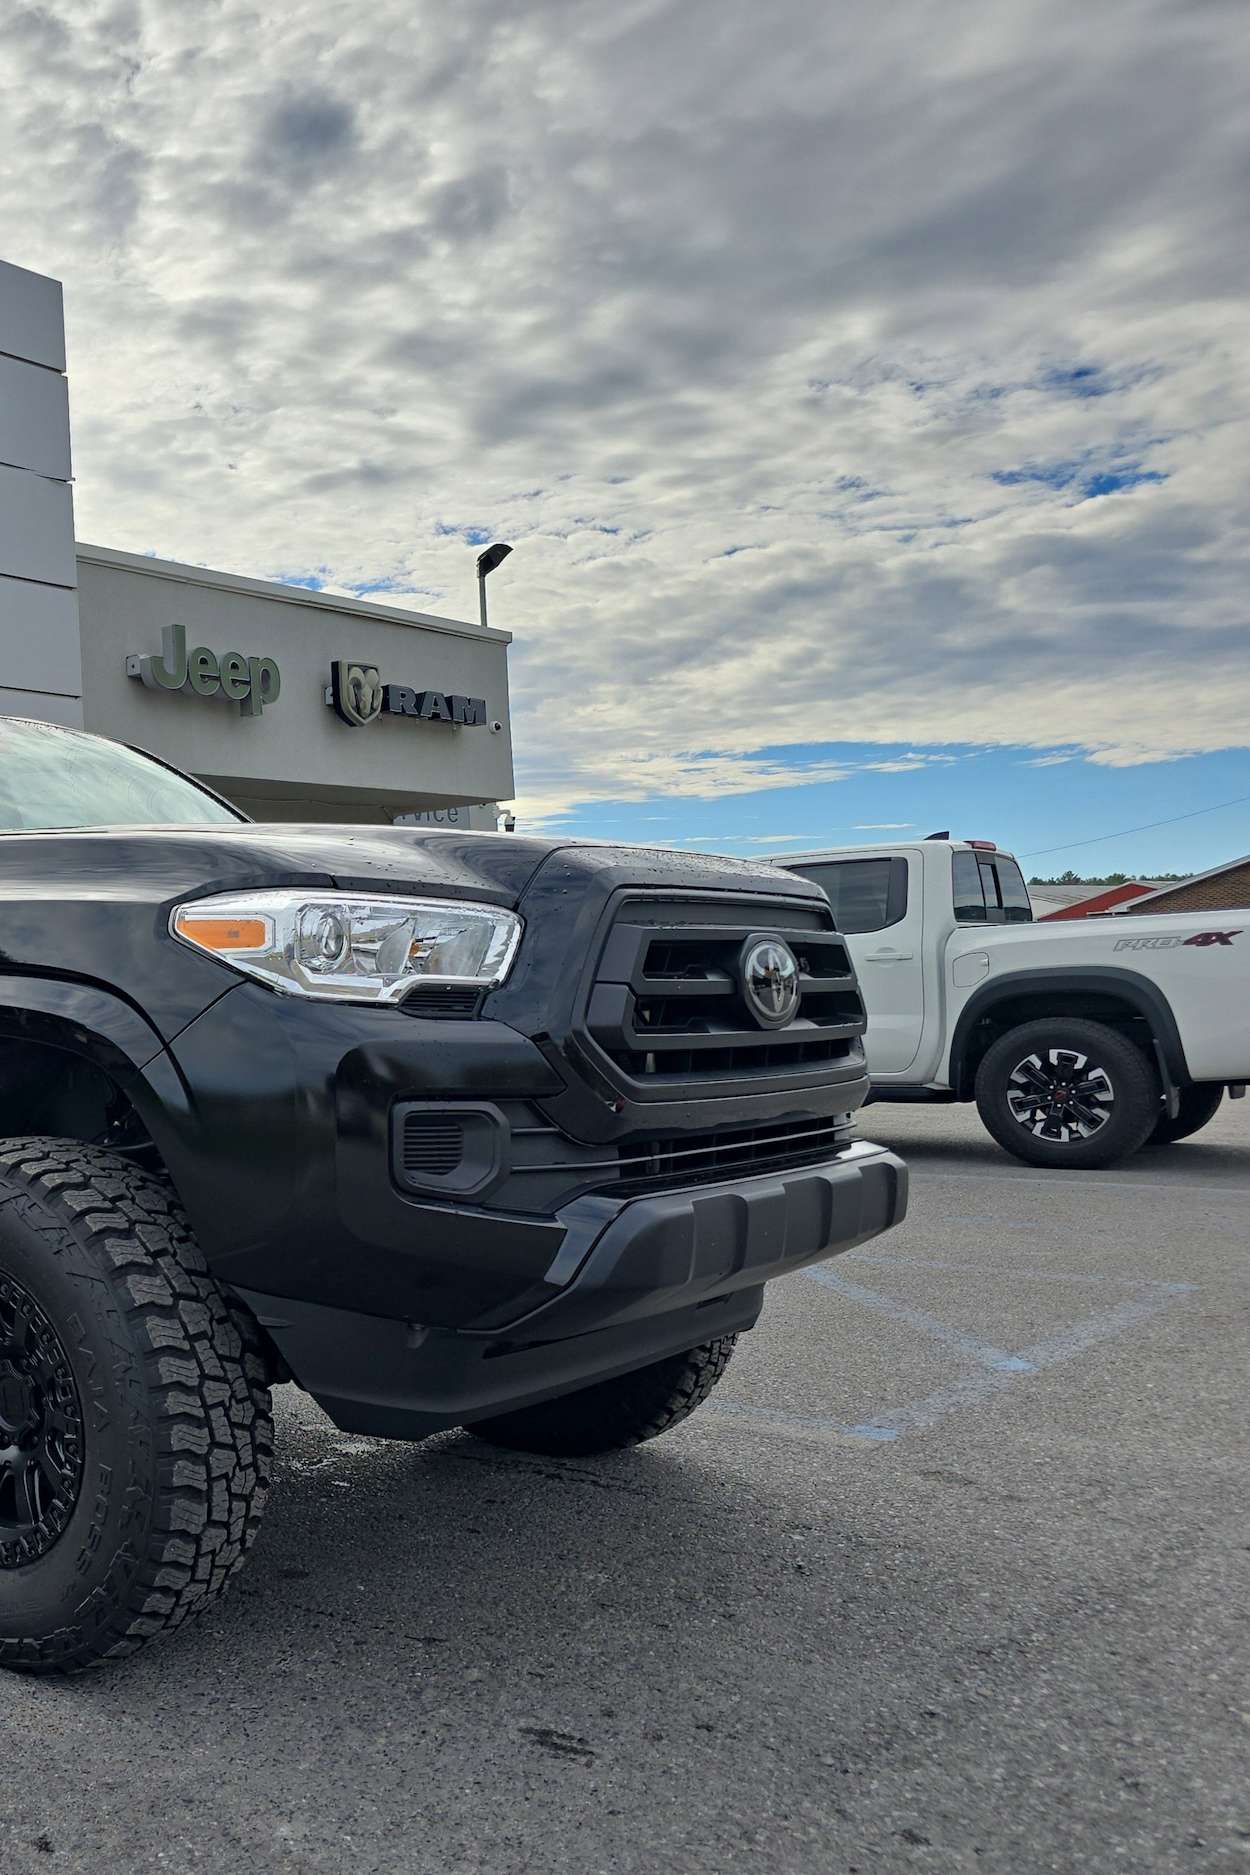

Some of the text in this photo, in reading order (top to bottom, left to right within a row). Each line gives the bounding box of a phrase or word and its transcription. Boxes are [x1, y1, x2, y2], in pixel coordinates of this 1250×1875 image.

[140, 624, 281, 717] Jeep
[382, 684, 487, 726] RAM
[67, 1312, 113, 1577] BAJA BOSS
